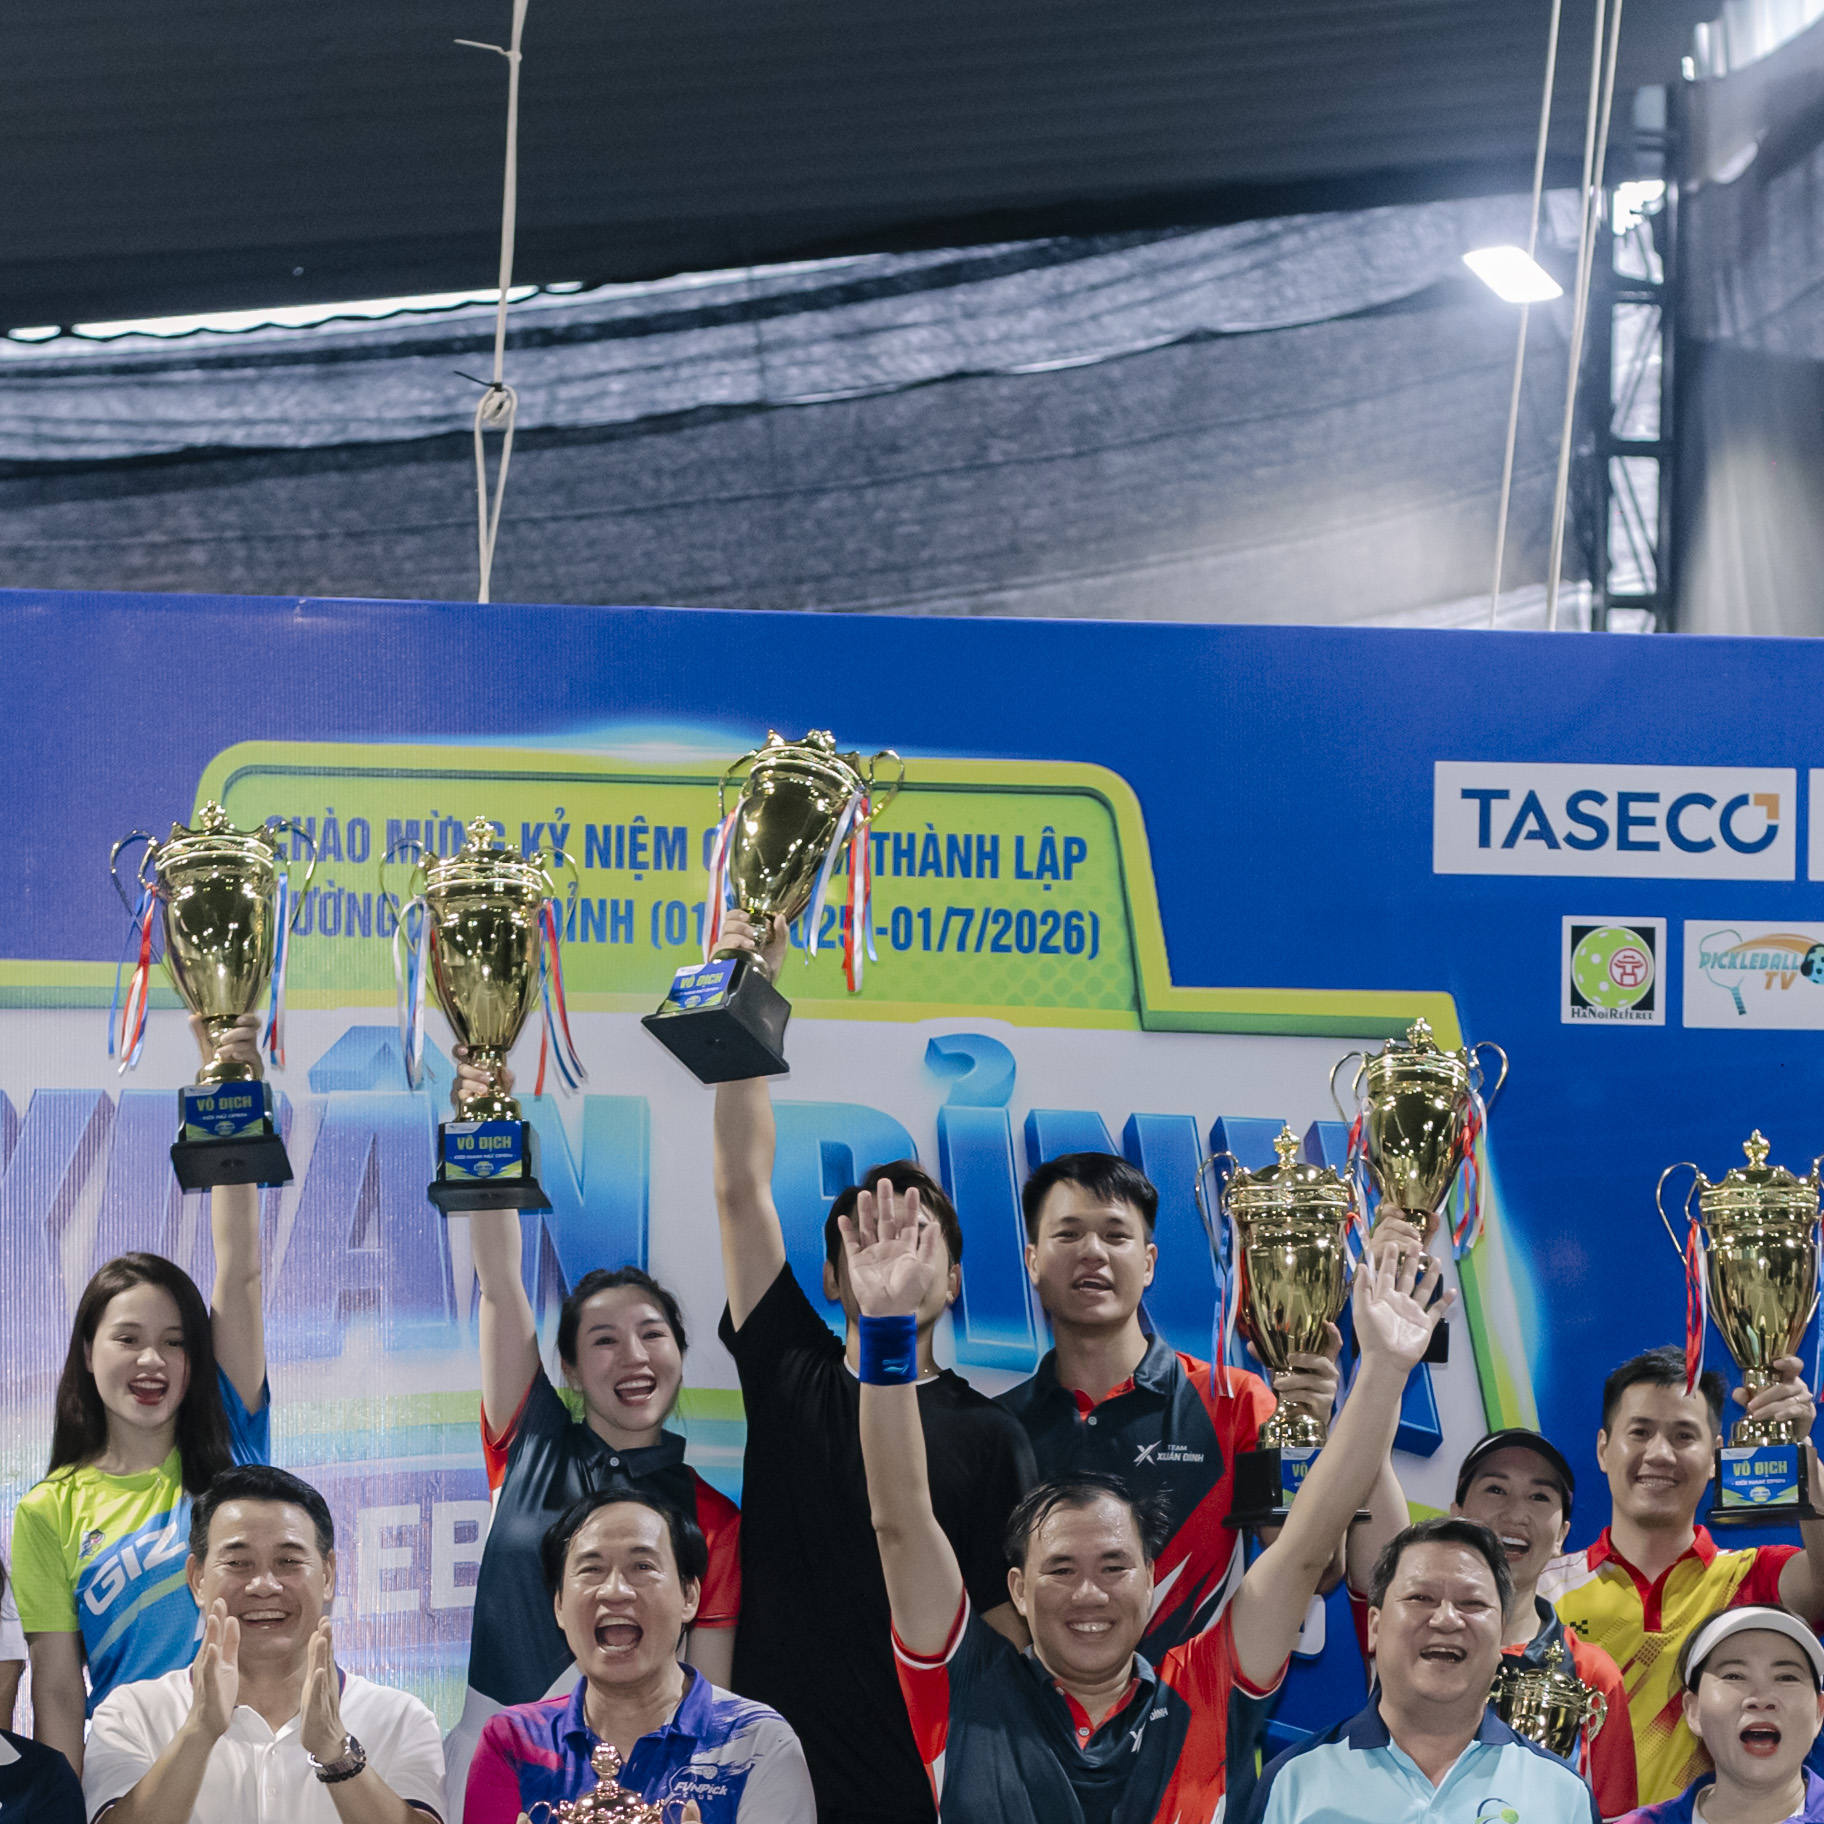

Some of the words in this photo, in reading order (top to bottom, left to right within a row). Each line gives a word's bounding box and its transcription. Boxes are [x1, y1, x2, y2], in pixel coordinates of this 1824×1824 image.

[1460, 788, 1781, 855] TASECO
[265, 807, 371, 864] CHÀO
[521, 807, 570, 869] KỶ
[584, 815, 688, 881] NIỆM
[869, 823, 1000, 879] THÀNH
[1014, 826, 1088, 891] LẬP
[289, 879, 400, 938] ƯỜNG
[1699, 951, 1800, 971] PICKLEBALL
[1764, 971, 1798, 991] TV
[196, 1096, 215, 1113] VÔ
[219, 1095, 253, 1112] ĐỊCH
[456, 1135, 475, 1151] VÔ
[478, 1135, 512, 1153] ĐỊCH
[1157, 1450, 1182, 1461] XUÂN
[1292, 1460, 1309, 1478] VÔ
[1732, 1458, 1751, 1477] VÔ
[1754, 1459, 1788, 1478] ĐỊCH
[83, 1521, 188, 1616] GIZ
